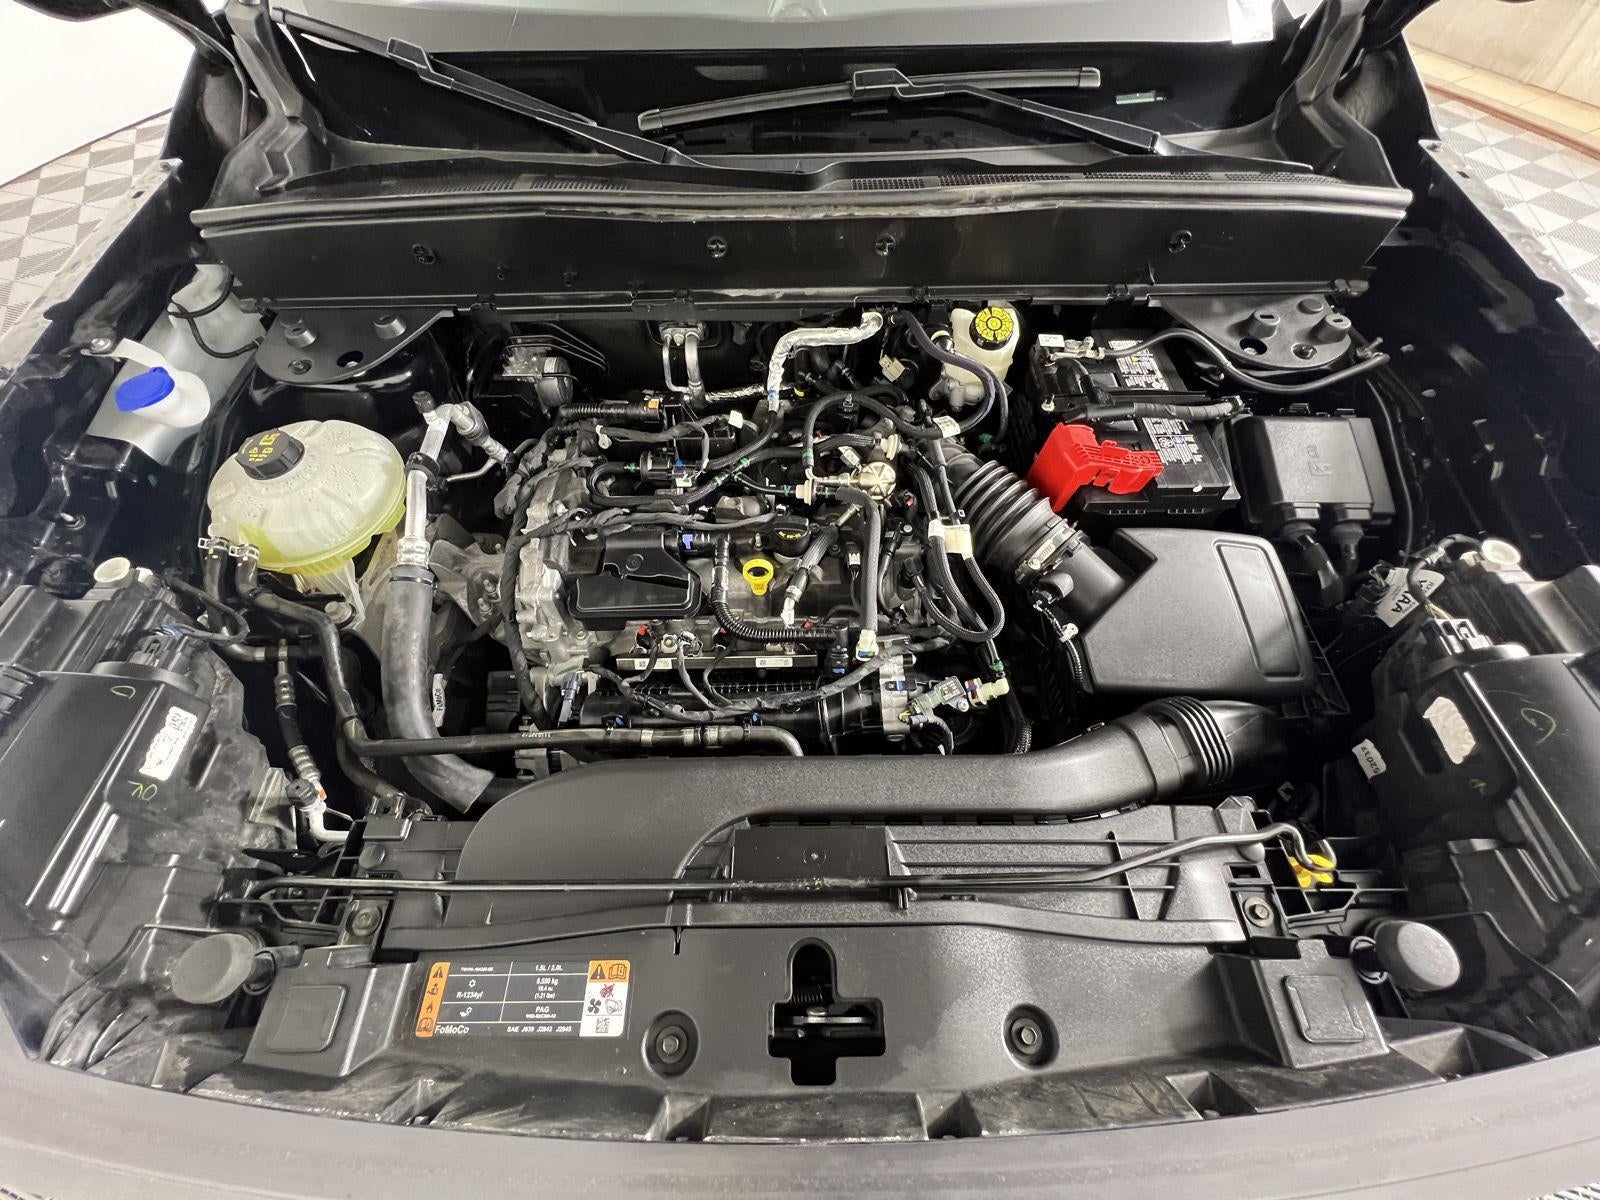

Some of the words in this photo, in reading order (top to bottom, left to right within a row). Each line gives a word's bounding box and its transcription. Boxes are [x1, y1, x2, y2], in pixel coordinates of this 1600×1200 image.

[456, 990, 484, 1000] R-1234yf
[535, 1005, 550, 1013] PAG
[434, 1024, 470, 1034] FoMoCo
[507, 1025, 519, 1033] SAE
